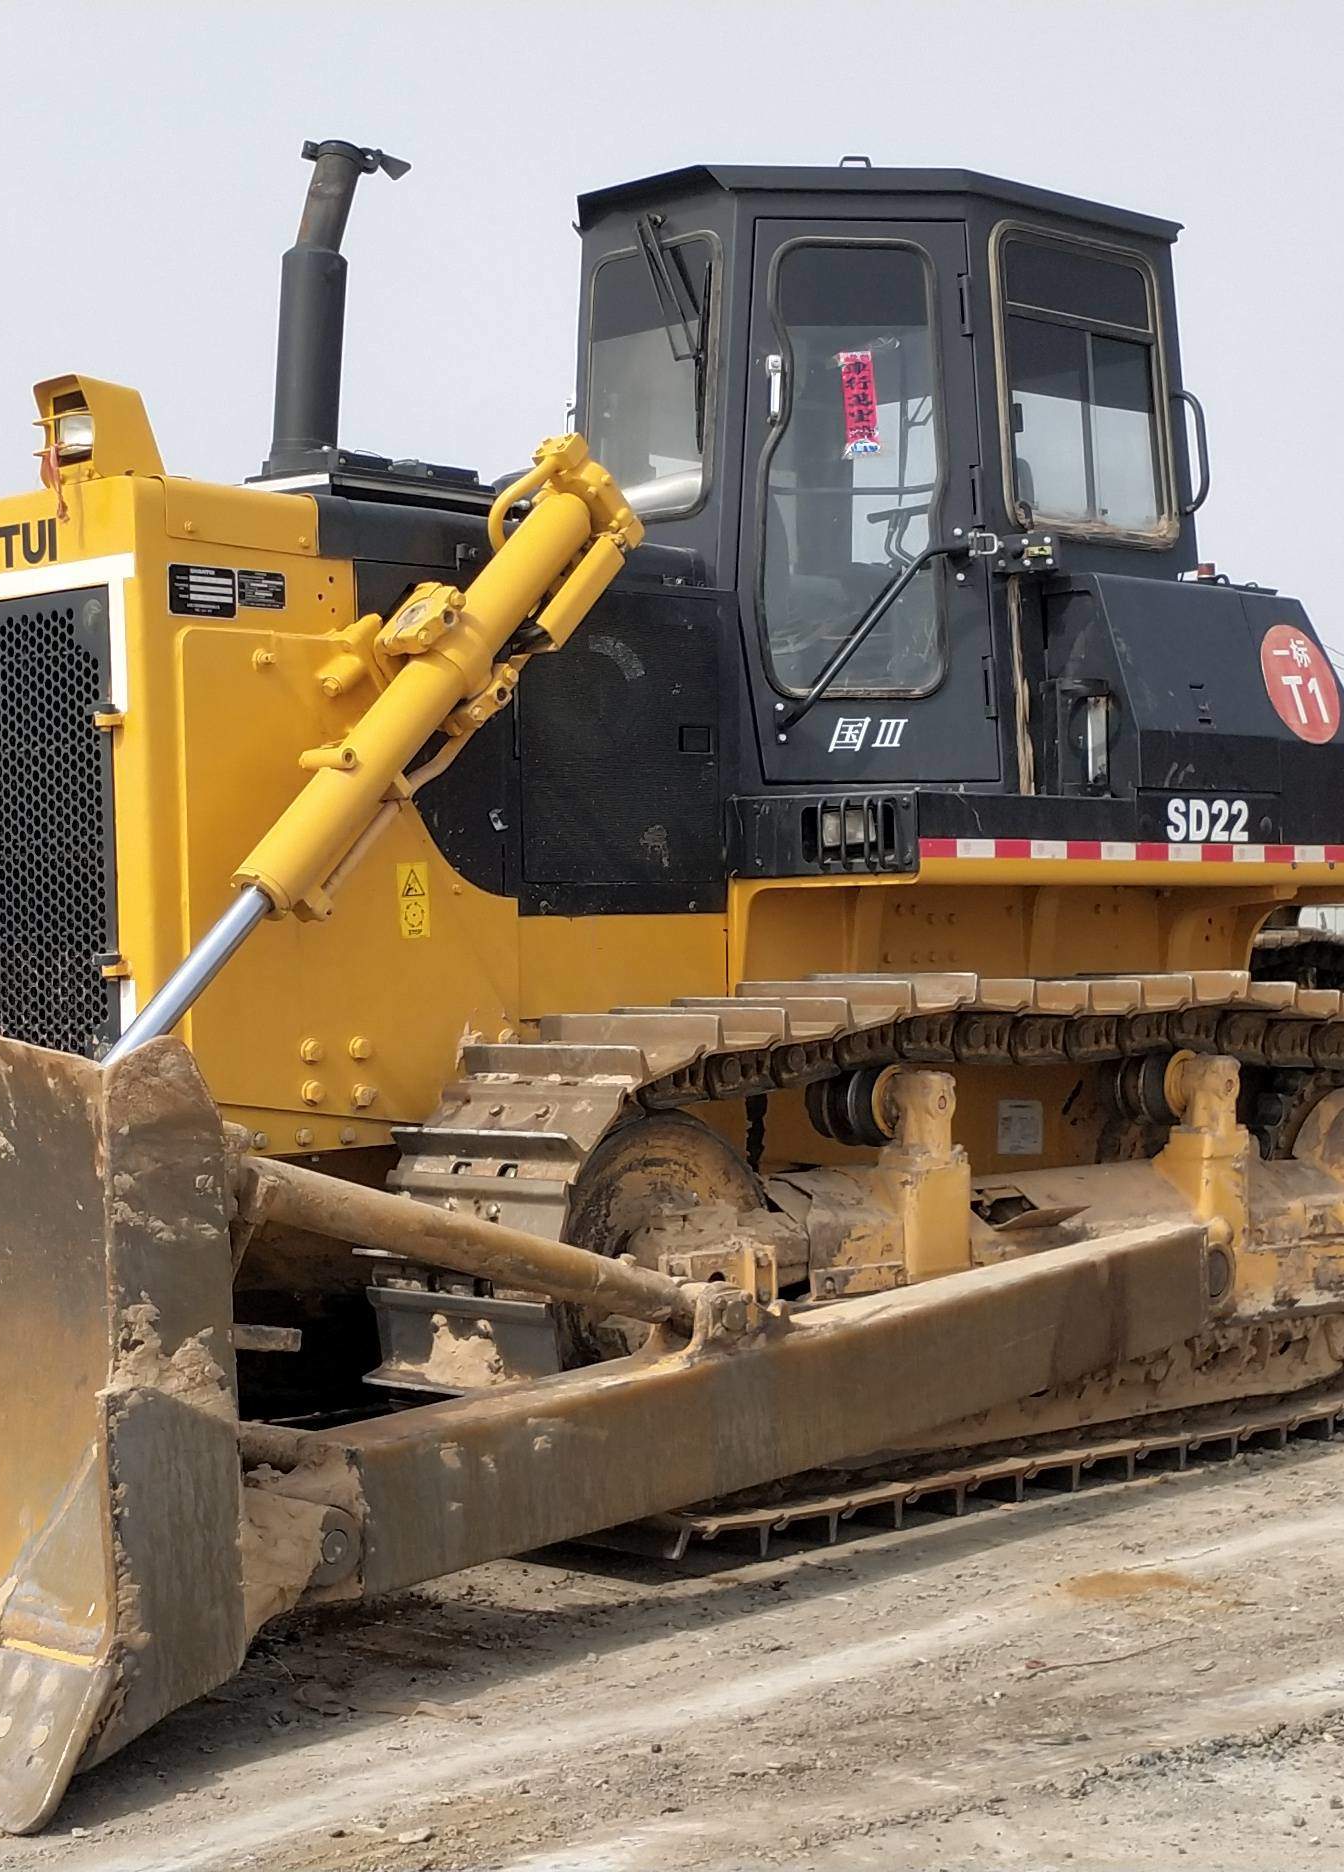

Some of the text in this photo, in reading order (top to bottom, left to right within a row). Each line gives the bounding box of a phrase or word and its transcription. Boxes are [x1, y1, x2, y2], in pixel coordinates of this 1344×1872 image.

[1272, 638, 1312, 669] 一标
[1281, 675, 1331, 725] T1
[1166, 798, 1249, 842] SD22
